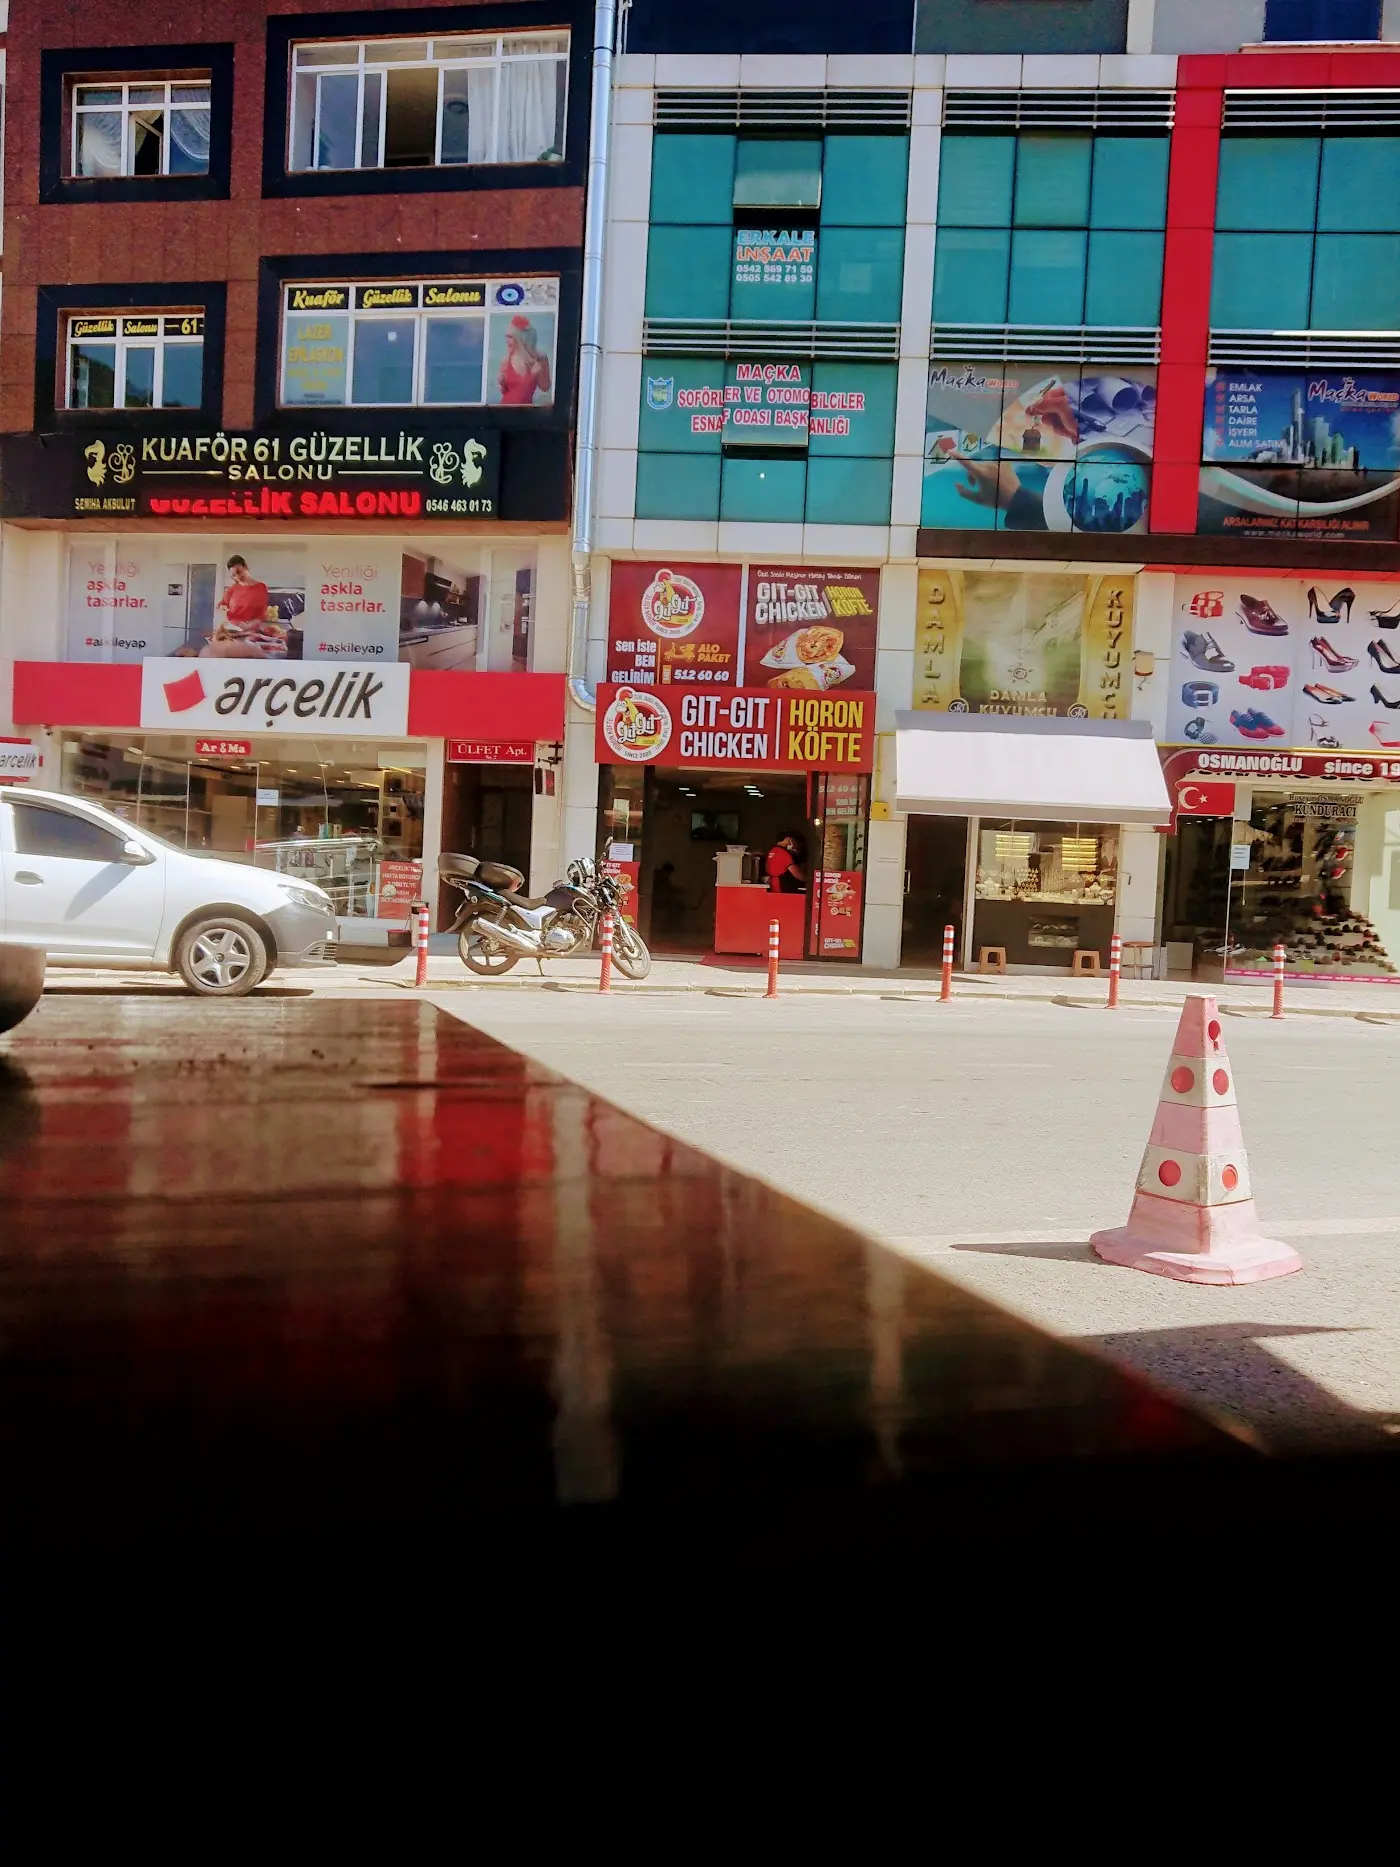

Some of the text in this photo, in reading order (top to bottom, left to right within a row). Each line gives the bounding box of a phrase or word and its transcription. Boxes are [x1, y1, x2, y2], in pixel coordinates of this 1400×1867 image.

[737, 230, 815, 246] ERKALE
[736, 265, 761, 273] 0542
[800, 265, 813, 273] 50
[736, 274, 761, 282] 0505
[763, 274, 782, 282] 542
[800, 274, 813, 282] 30
[293, 287, 481, 309] Kuaför Güzellik Salonu
[74, 320, 115, 337] Güzellik
[124, 320, 158, 334] Salonu
[736, 364, 802, 385] MAÇKA
[928, 366, 987, 391] Maçka
[744, 387, 761, 403] VE
[1229, 383, 1263, 392] EMLAK
[1308, 378, 1368, 403] Maçka
[1228, 394, 1256, 403] ARSA
[1228, 405, 1258, 414] TARLA
[691, 408, 850, 437] ESNAF ODASI BAŞKANLIĞI
[141, 431, 425, 462] KUAFÖR 61 GÜZELLİK
[228, 464, 332, 480] SALONU
[300, 491, 421, 515] SALONU
[426, 499, 492, 513] 0546 463 01 73
[322, 563, 379, 582] Yeniliği
[320, 581, 363, 597] aşkla
[757, 582, 820, 603] GIT-GIT
[320, 598, 386, 613] tasarlar.
[755, 601, 828, 624] CHICKEN
[318, 641, 384, 655] #aşkileyap
[698, 643, 721, 654] ALO
[635, 654, 656, 667] BEN
[697, 653, 732, 664] PAKET
[673, 669, 696, 680] 512
[697, 669, 713, 681] 60
[714, 670, 730, 682] 60
[214, 671, 384, 728] arçelik
[990, 689, 1048, 702] DAMLA
[681, 694, 771, 729] GIT-GIT
[789, 699, 865, 728] HORON
[979, 704, 1058, 717] KUYUMCU
[201, 742, 246, 753] Ar & Ma
[457, 743, 528, 757] ÜLFET Apt.
[680, 731, 768, 760] CHICKEN
[788, 726, 863, 762] KÖFTE
[1198, 752, 1303, 773] OSMANOĞLU
[1324, 759, 1374, 776] since
[1294, 804, 1357, 817] KUNDURACI
